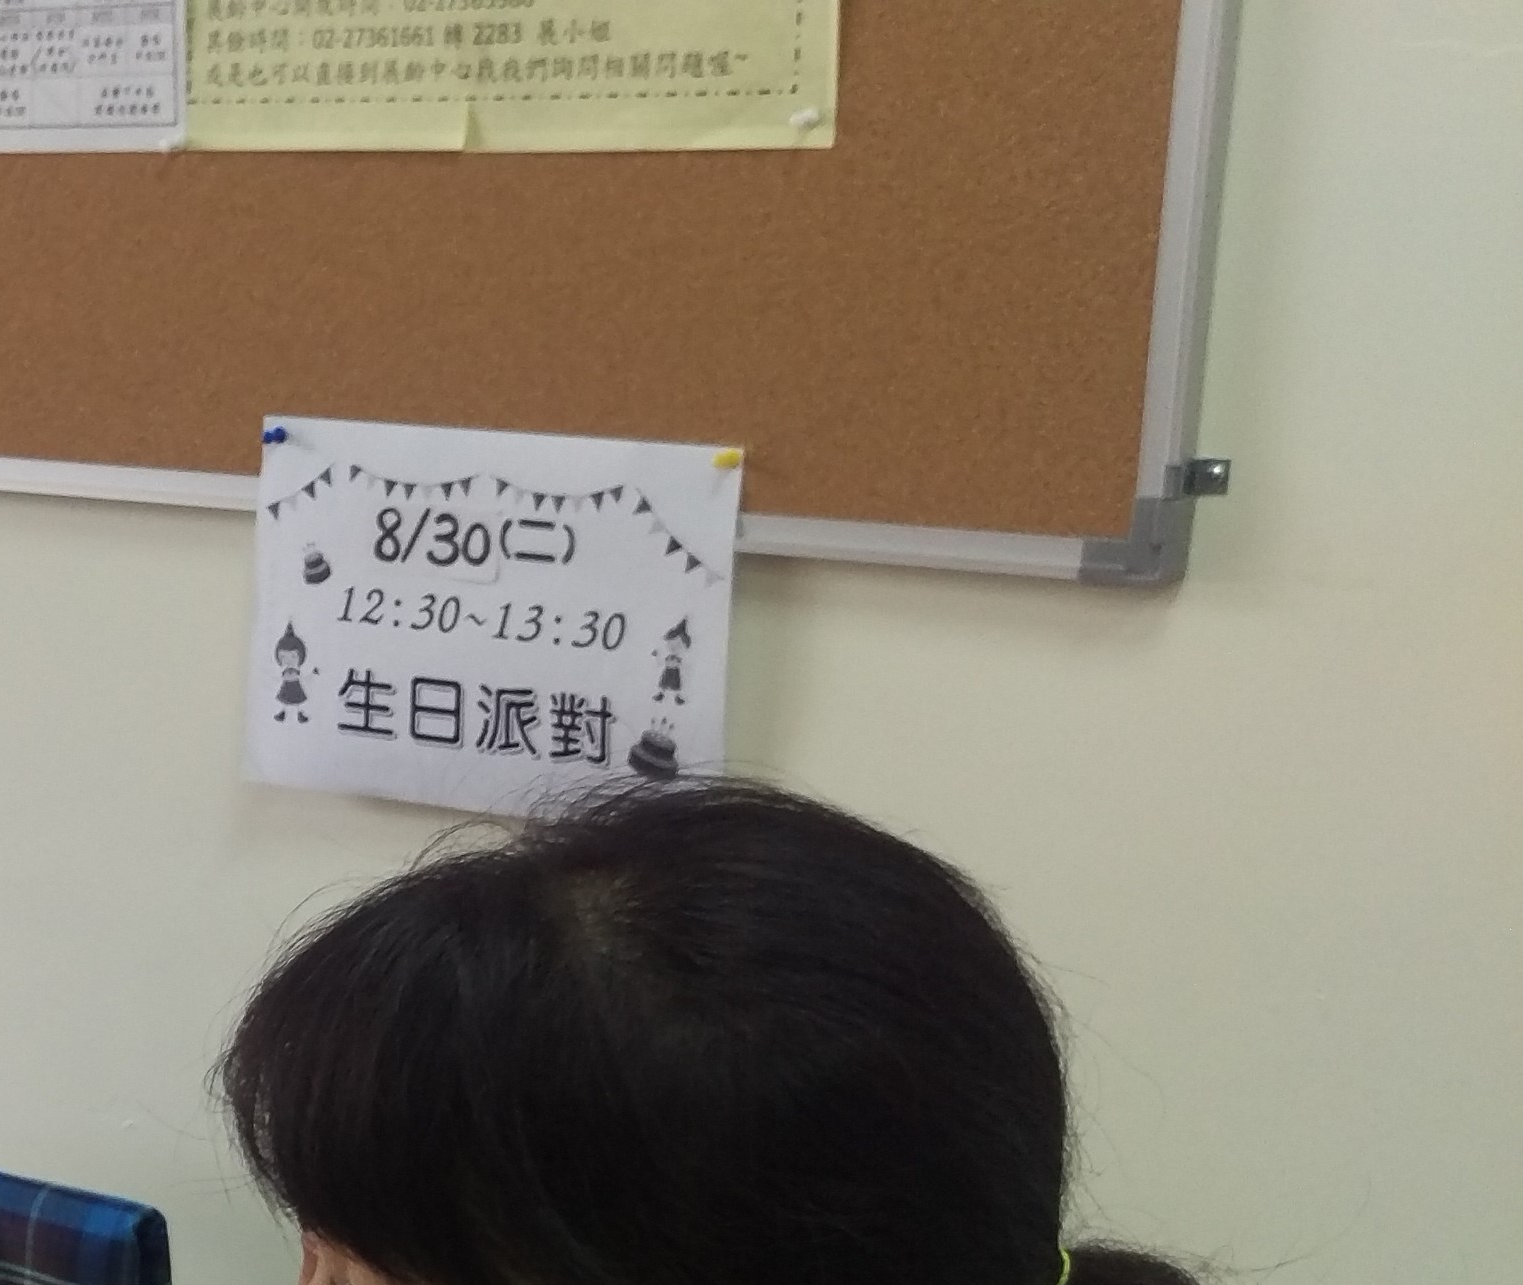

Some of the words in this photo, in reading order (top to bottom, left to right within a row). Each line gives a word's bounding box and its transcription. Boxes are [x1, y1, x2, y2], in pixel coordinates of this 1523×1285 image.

[373, 506, 577, 568] 8/30(二)
[337, 585, 627, 650] 12:30~13:30
[337, 668, 616, 766] 生日派對
